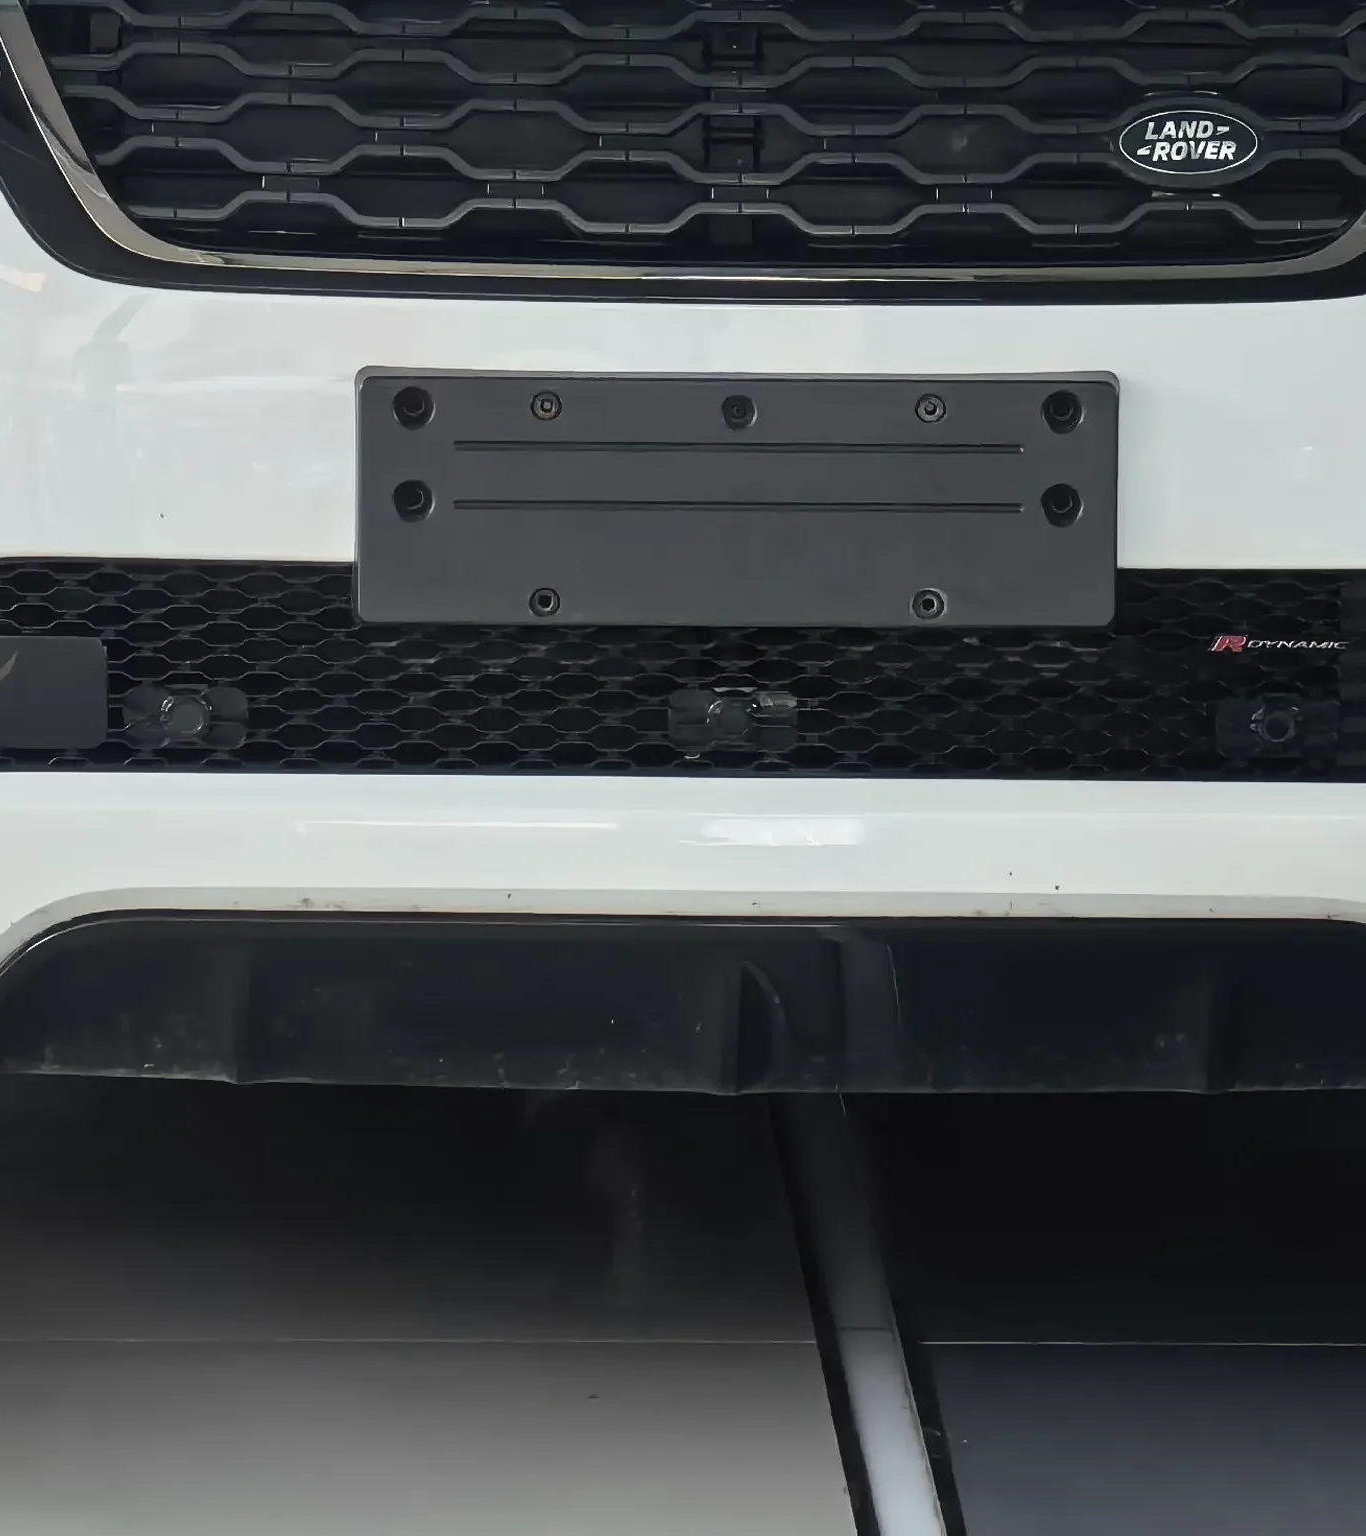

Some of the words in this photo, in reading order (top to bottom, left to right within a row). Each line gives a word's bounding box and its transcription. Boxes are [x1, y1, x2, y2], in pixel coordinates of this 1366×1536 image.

[1145, 120, 1214, 140] LAND
[1152, 140, 1237, 162] ROVER
[1248, 639, 1348, 650] DYNAMIC
